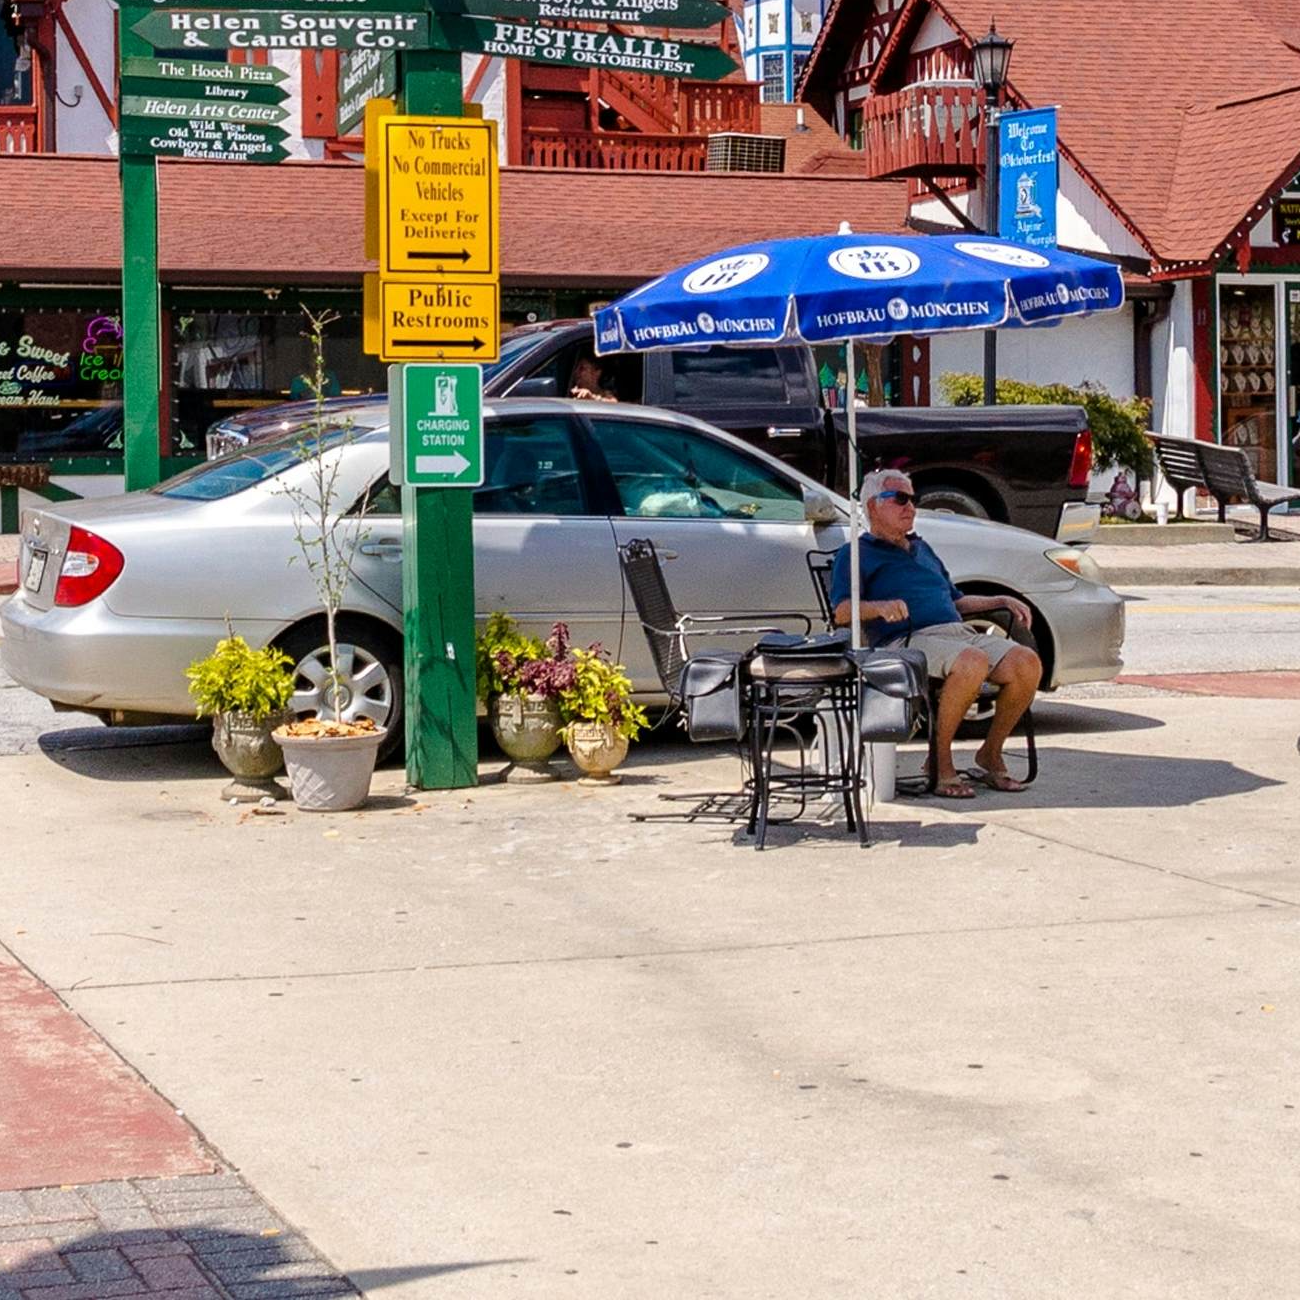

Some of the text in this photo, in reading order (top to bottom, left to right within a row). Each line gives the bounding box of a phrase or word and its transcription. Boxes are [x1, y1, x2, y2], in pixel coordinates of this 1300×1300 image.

[170, 13, 418, 30] Helen Souvenir
[538, 4, 641, 22] Restaurant
[182, 30, 407, 48] & Candle Co.
[494, 23, 681, 61] FESTHALLE
[483, 42, 695, 74] HOME OF OKTOBERFEST
[158, 62, 273, 80] The Hooch Pizza
[205, 86, 249, 99] Library
[143, 100, 280, 120] Helen Arts Center
[168, 127, 266, 142] Old Time Photos
[189, 120, 246, 132] Wild West
[1008, 123, 1048, 139] Welcome
[150, 137, 273, 154] Cowboys & Angels
[408, 129, 471, 151] No Trucks
[183, 149, 248, 160] Restaurant
[1000, 150, 1056, 168] Oktoberfest
[392, 155, 486, 177] No Commercial
[416, 180, 464, 202] Vehicles
[400, 208, 480, 225] Except For
[404, 224, 477, 241] Deliveries
[408, 287, 472, 308] Public
[1020, 291, 1059, 312] HOFBRÄU
[392, 310, 490, 329] Restrooms
[817, 307, 886, 328] HOFBRÄU
[911, 301, 990, 319] MÜNCHEN
[634, 321, 698, 342] HOFBRÄU
[715, 317, 776, 333] MÜNCHEN
[16, 334, 70, 368] Sweet
[80, 352, 104, 366] Ice
[16, 364, 57, 383] Coffee
[26, 389, 61, 406] Haus
[417, 419, 470, 432] CHARGING
[422, 433, 465, 447] STATION
